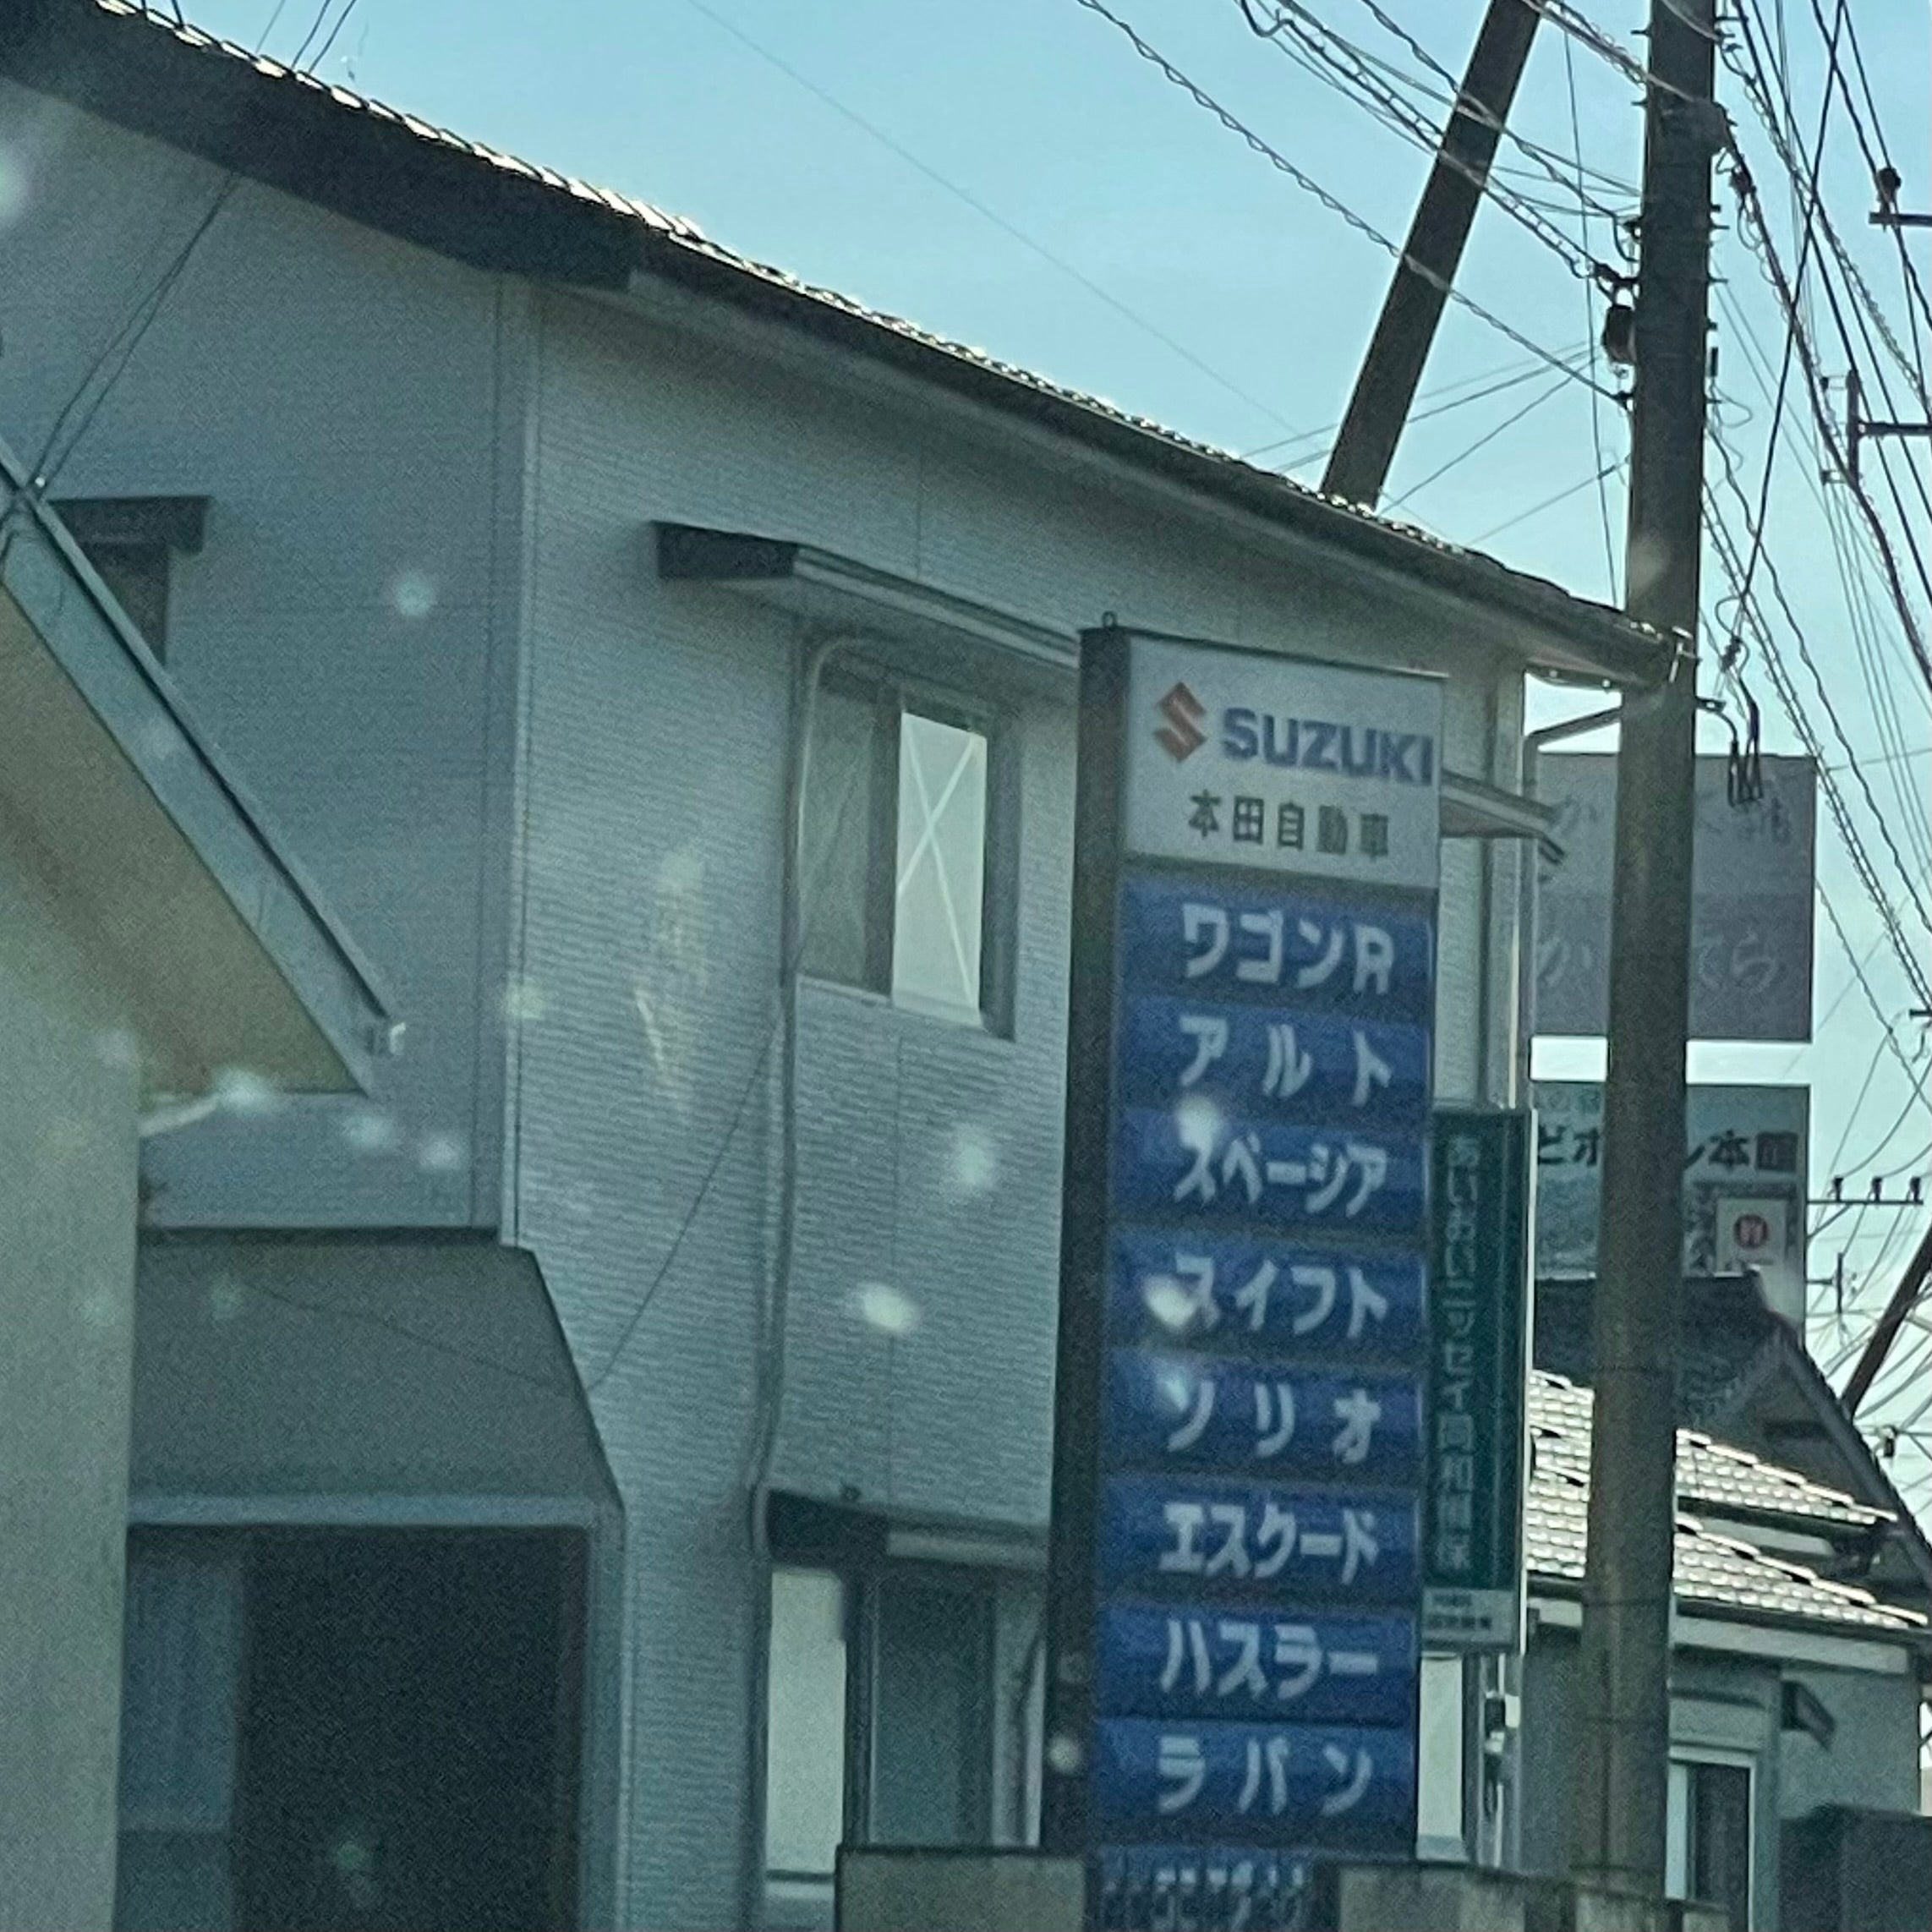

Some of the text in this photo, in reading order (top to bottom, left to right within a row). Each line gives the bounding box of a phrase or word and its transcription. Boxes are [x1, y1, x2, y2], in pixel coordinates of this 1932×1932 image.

[1222, 708, 1433, 786] SUZUKI
[1187, 789, 1389, 861] 本田自動車
[1183, 902, 1395, 995] ワゴンR
[1179, 1016, 1393, 1106] アルト
[1170, 1251, 1389, 1340] スイフト
[1165, 1378, 1383, 1465] ソリオ
[1158, 1502, 1381, 1586] エスクード
[1159, 1618, 1379, 1699] ハスラー
[1158, 1735, 1373, 1816] ラパン
